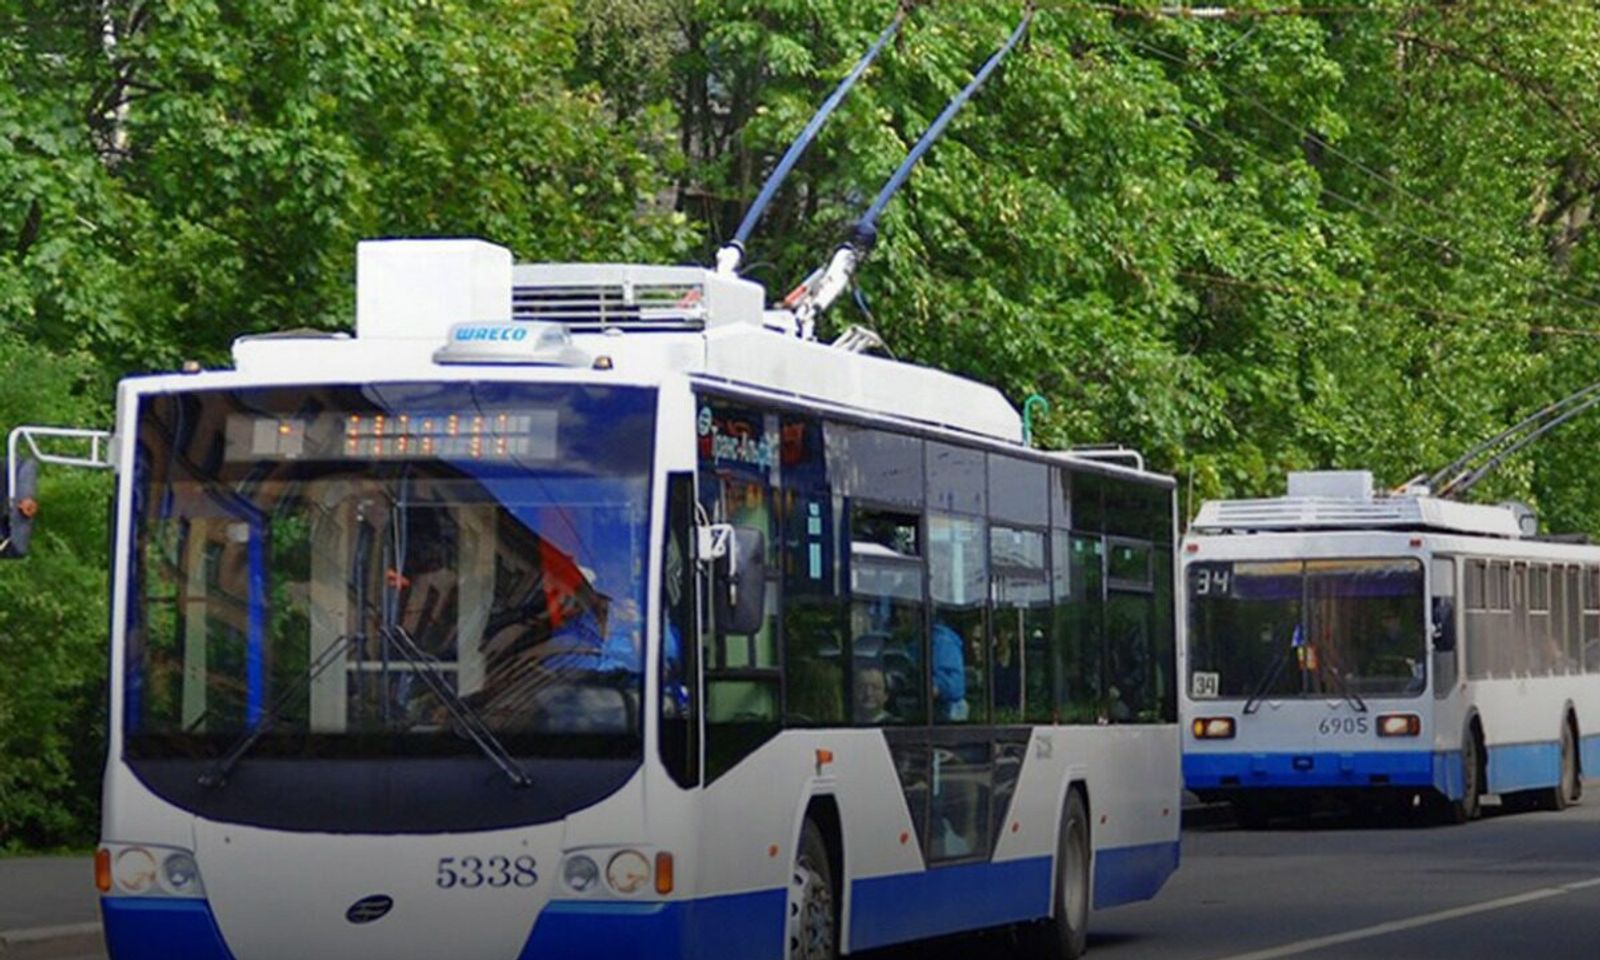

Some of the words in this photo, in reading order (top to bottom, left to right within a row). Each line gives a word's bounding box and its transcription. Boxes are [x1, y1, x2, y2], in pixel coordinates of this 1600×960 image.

[1196, 569, 1230, 595] 34
[1318, 717, 1369, 736] 6905
[436, 855, 539, 889] 5338
